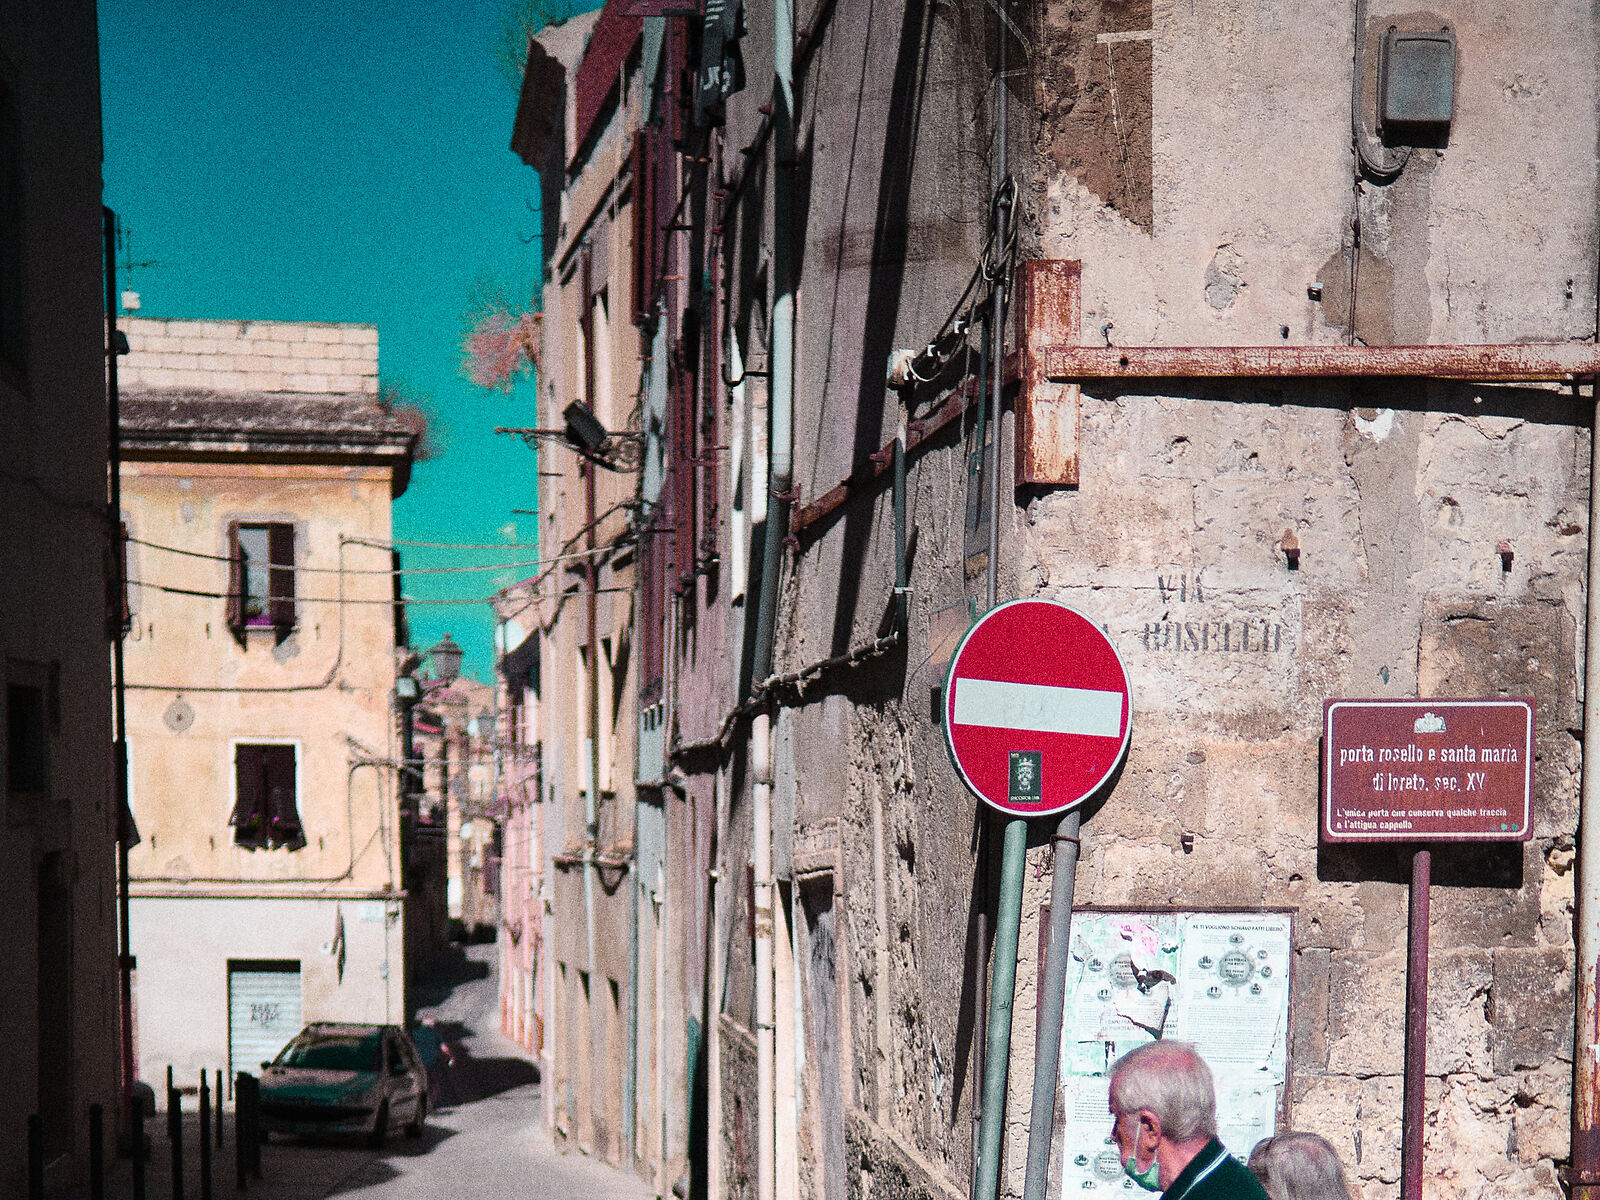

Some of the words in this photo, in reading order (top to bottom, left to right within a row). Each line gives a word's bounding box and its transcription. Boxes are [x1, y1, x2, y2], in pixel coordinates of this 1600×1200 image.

[1339, 744, 1374, 767] porta
[1378, 743, 1424, 762] rosello
[1428, 748, 1437, 761] e
[1440, 744, 1477, 762] santa
[1372, 772, 1384, 791] di
[1434, 776, 1461, 792] sec.
[1466, 772, 1486, 791] XV
[1368, 808, 1389, 818] porta
[1446, 808, 1477, 819] qualche
[1480, 808, 1507, 817] traccia
